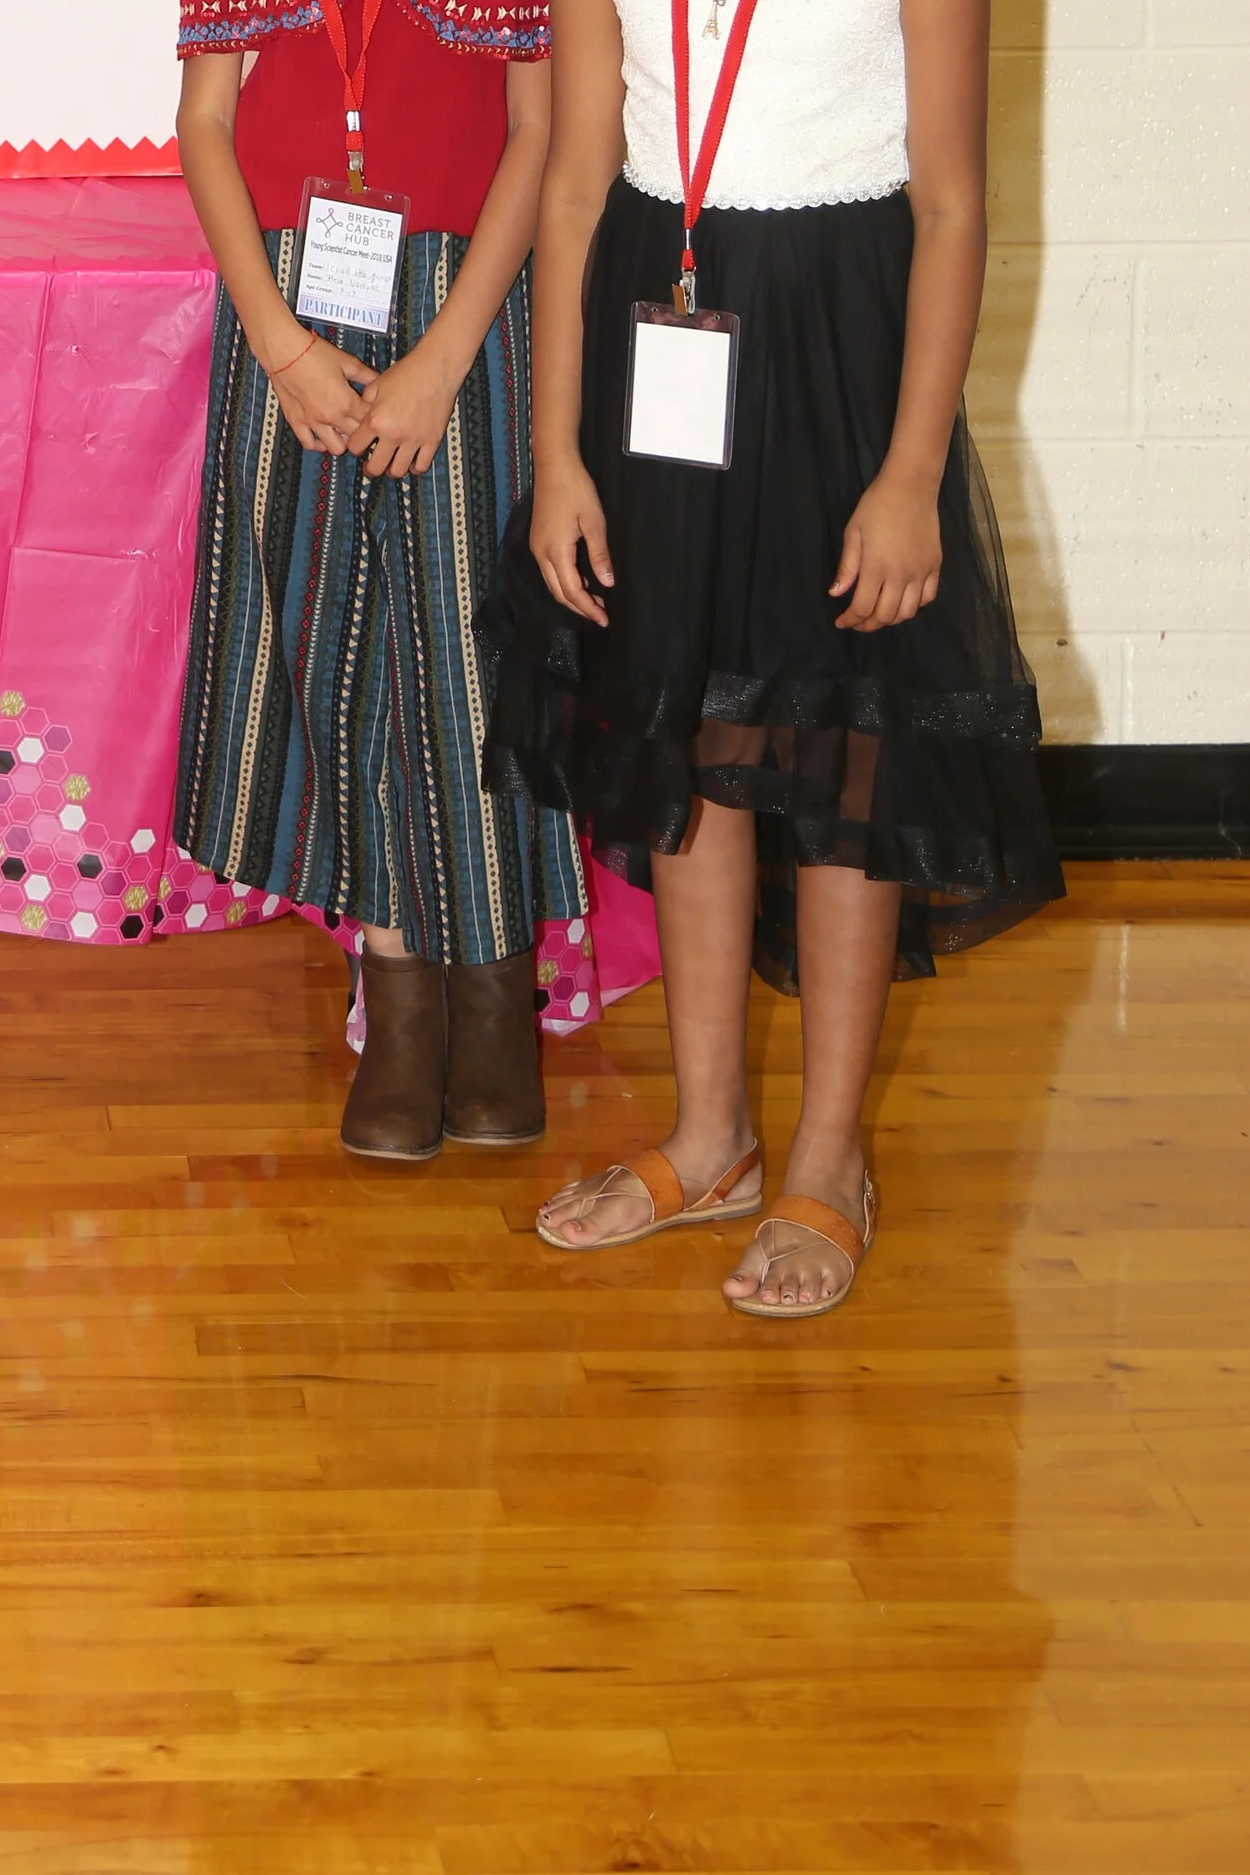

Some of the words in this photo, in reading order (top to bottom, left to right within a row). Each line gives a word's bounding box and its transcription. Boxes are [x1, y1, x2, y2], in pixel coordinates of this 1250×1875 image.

[347, 212, 392, 229] BREAST
[345, 234, 370, 246] HUB
[346, 223, 394, 241] CANCER
[304, 298, 384, 326] PARTICIPANT
